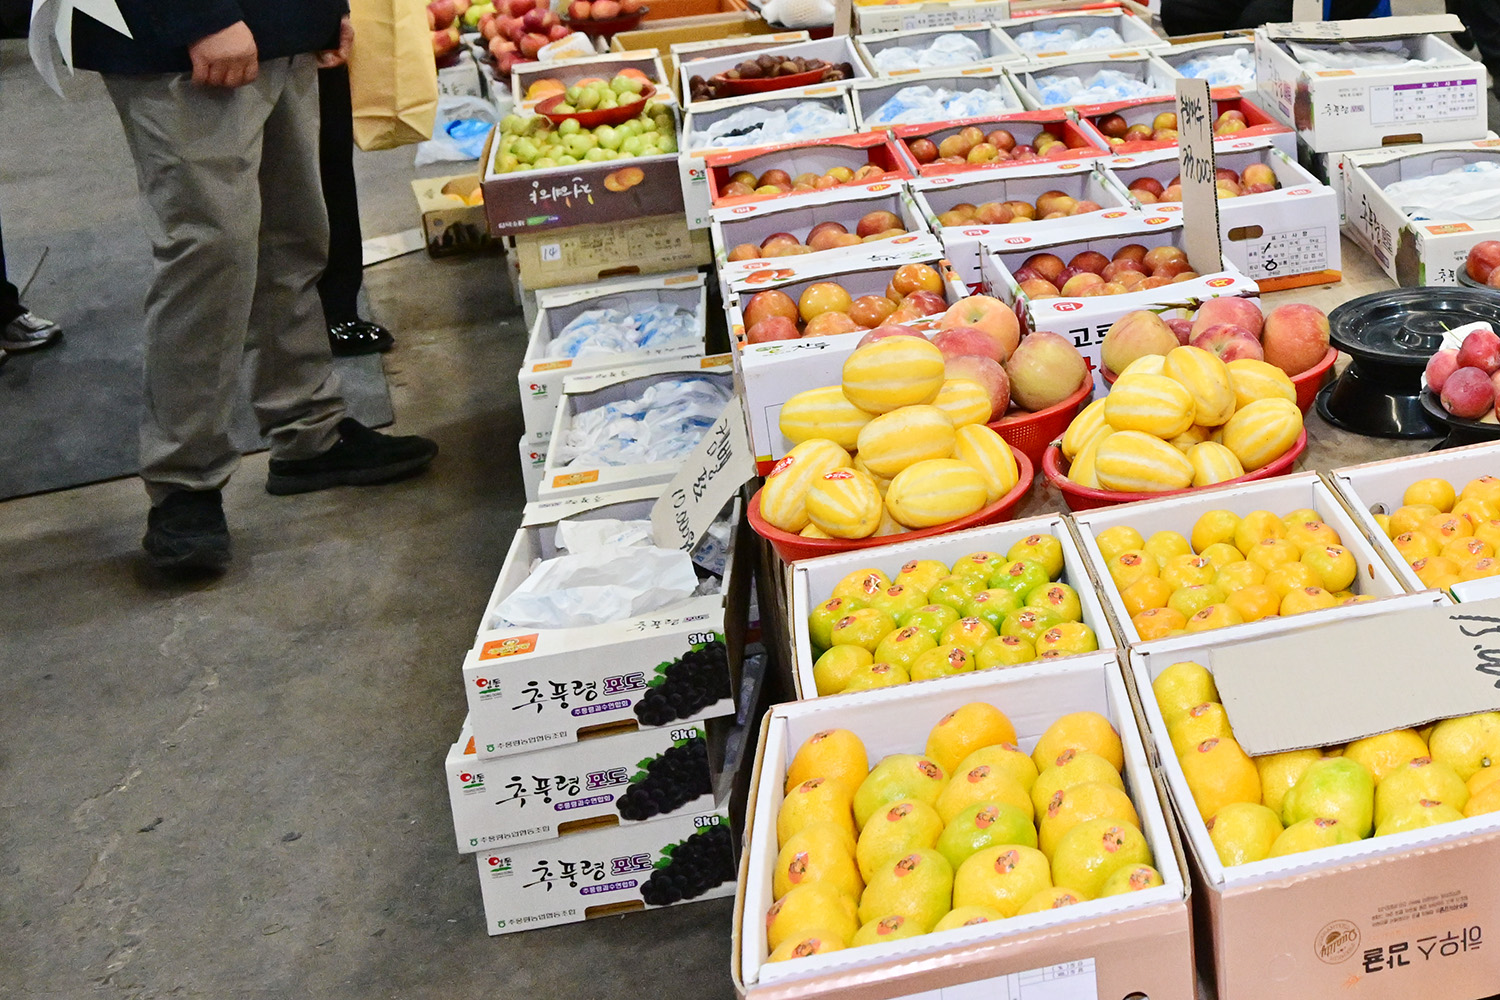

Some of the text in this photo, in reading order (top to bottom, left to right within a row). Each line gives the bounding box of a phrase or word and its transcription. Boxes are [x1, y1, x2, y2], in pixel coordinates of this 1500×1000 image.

[529, 177, 592, 205] 천혜향
[688, 631, 715, 647] 3kg
[512, 672, 648, 714] 추풍령 포도
[671, 727, 697, 742] 3kg
[496, 767, 630, 808] 추풍령 포도
[694, 815, 720, 828] 3kg
[523, 853, 654, 893] 추풍령 포도
[1361, 925, 1482, 974] 하우스 감귤
